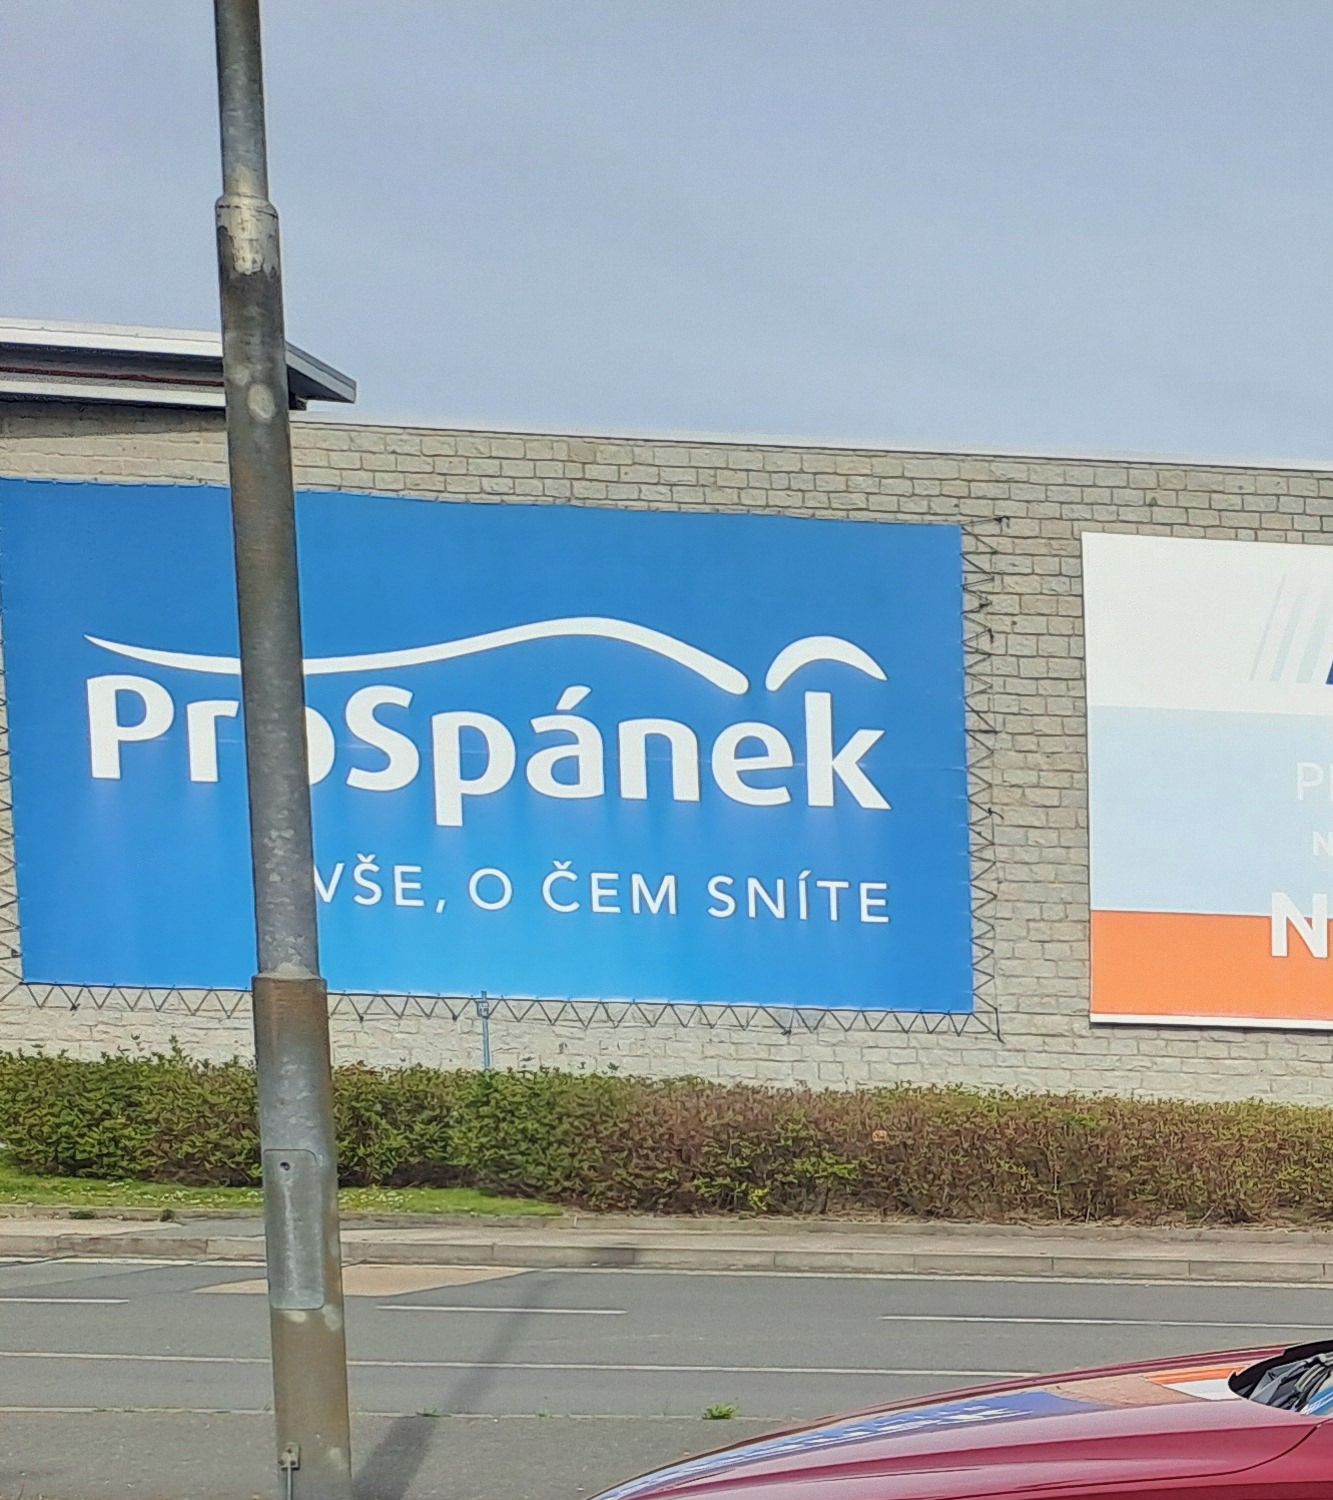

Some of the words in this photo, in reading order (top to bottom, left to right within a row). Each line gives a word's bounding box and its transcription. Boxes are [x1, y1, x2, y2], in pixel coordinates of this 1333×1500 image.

[314, 853, 446, 913] VŠE,
[468, 867, 513, 911] O
[542, 860, 678, 915] ČEM
[706, 870, 889, 923] SNÍTE
